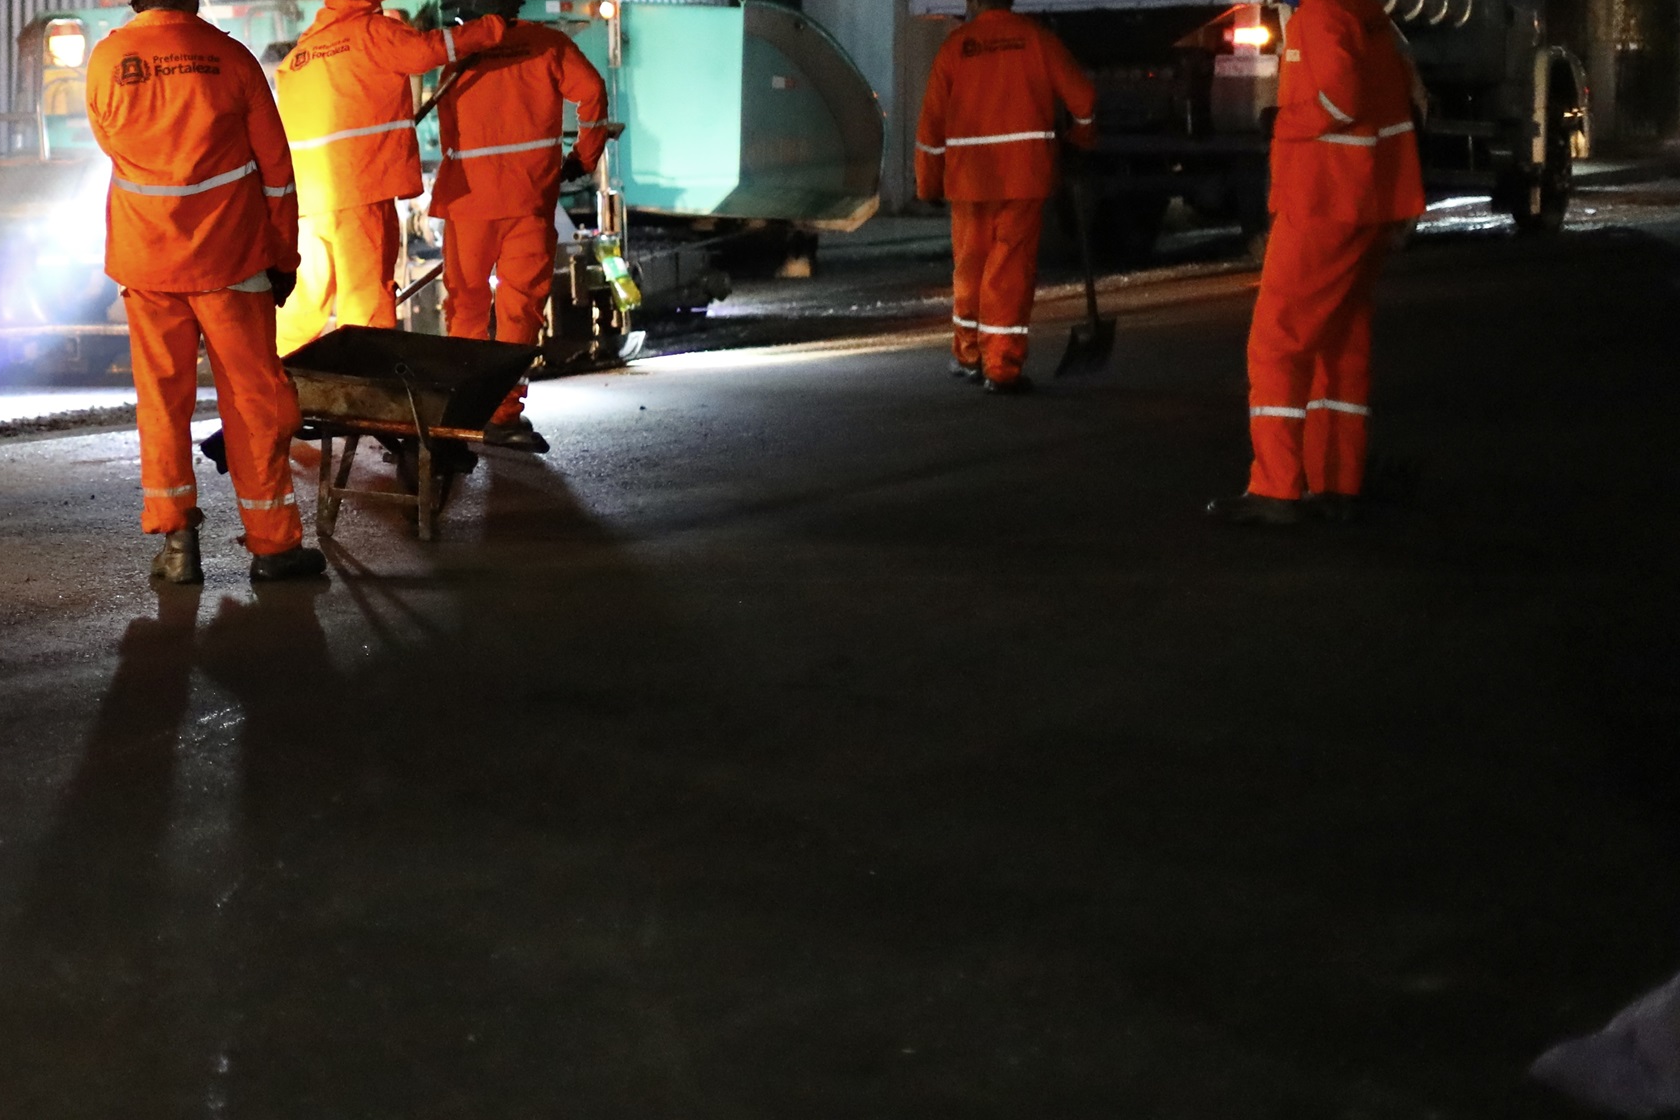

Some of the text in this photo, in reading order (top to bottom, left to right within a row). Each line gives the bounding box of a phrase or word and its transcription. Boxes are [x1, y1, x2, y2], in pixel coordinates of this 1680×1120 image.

[152, 54, 221, 64] Prefeitura de
[154, 62, 221, 77] Fortaleza
